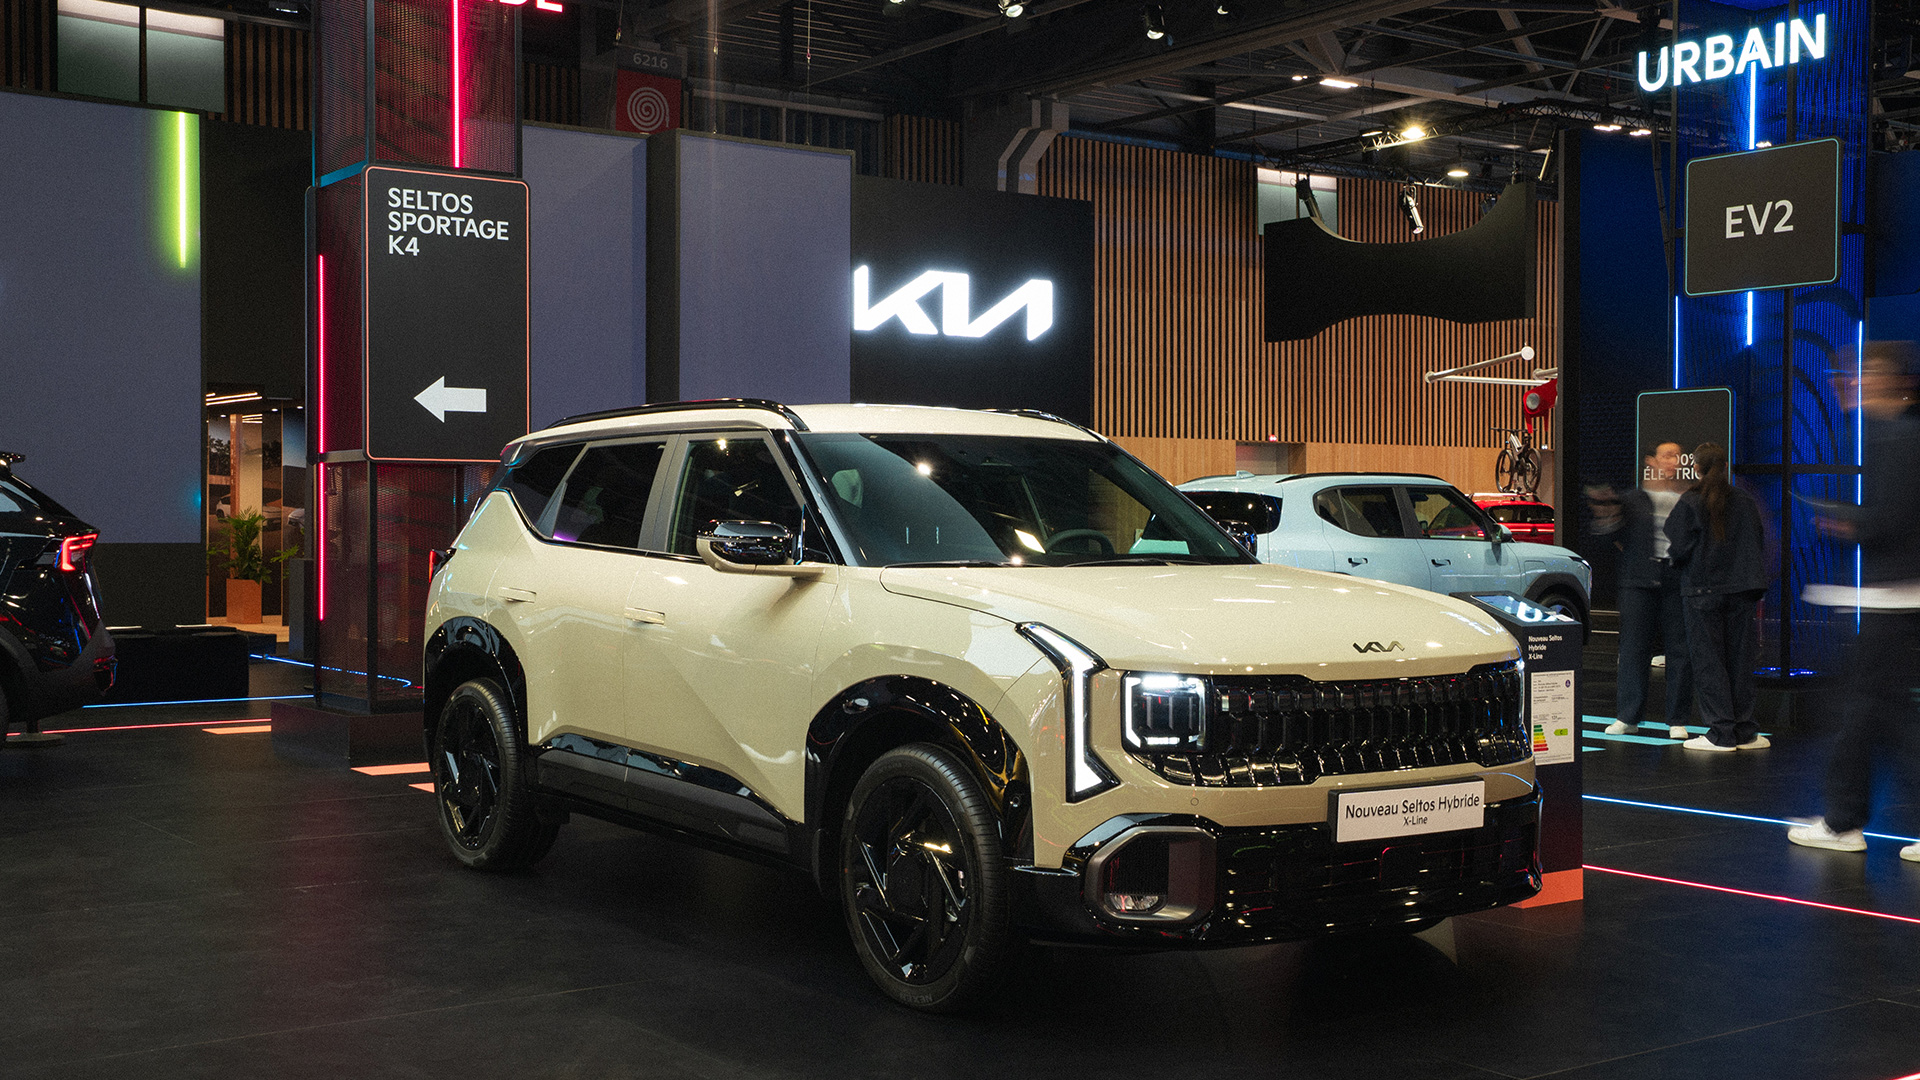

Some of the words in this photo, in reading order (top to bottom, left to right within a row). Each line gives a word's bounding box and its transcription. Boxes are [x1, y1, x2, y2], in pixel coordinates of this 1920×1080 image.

[632, 52, 669, 69] 6216
[1637, 13, 1826, 92] URBAIN
[387, 187, 474, 215] SELTOS
[387, 210, 510, 241] SPORTAGE
[1725, 199, 1794, 239] EV2
[388, 234, 420, 257] K4
[1528, 635, 1549, 643] Nouveau
[1528, 644, 1547, 652] Hybride
[1345, 804, 1399, 819] Nouveau
[1401, 799, 1436, 814] Seltos
[1438, 793, 1480, 813] Hybride
[1403, 816, 1428, 826] X-Line
